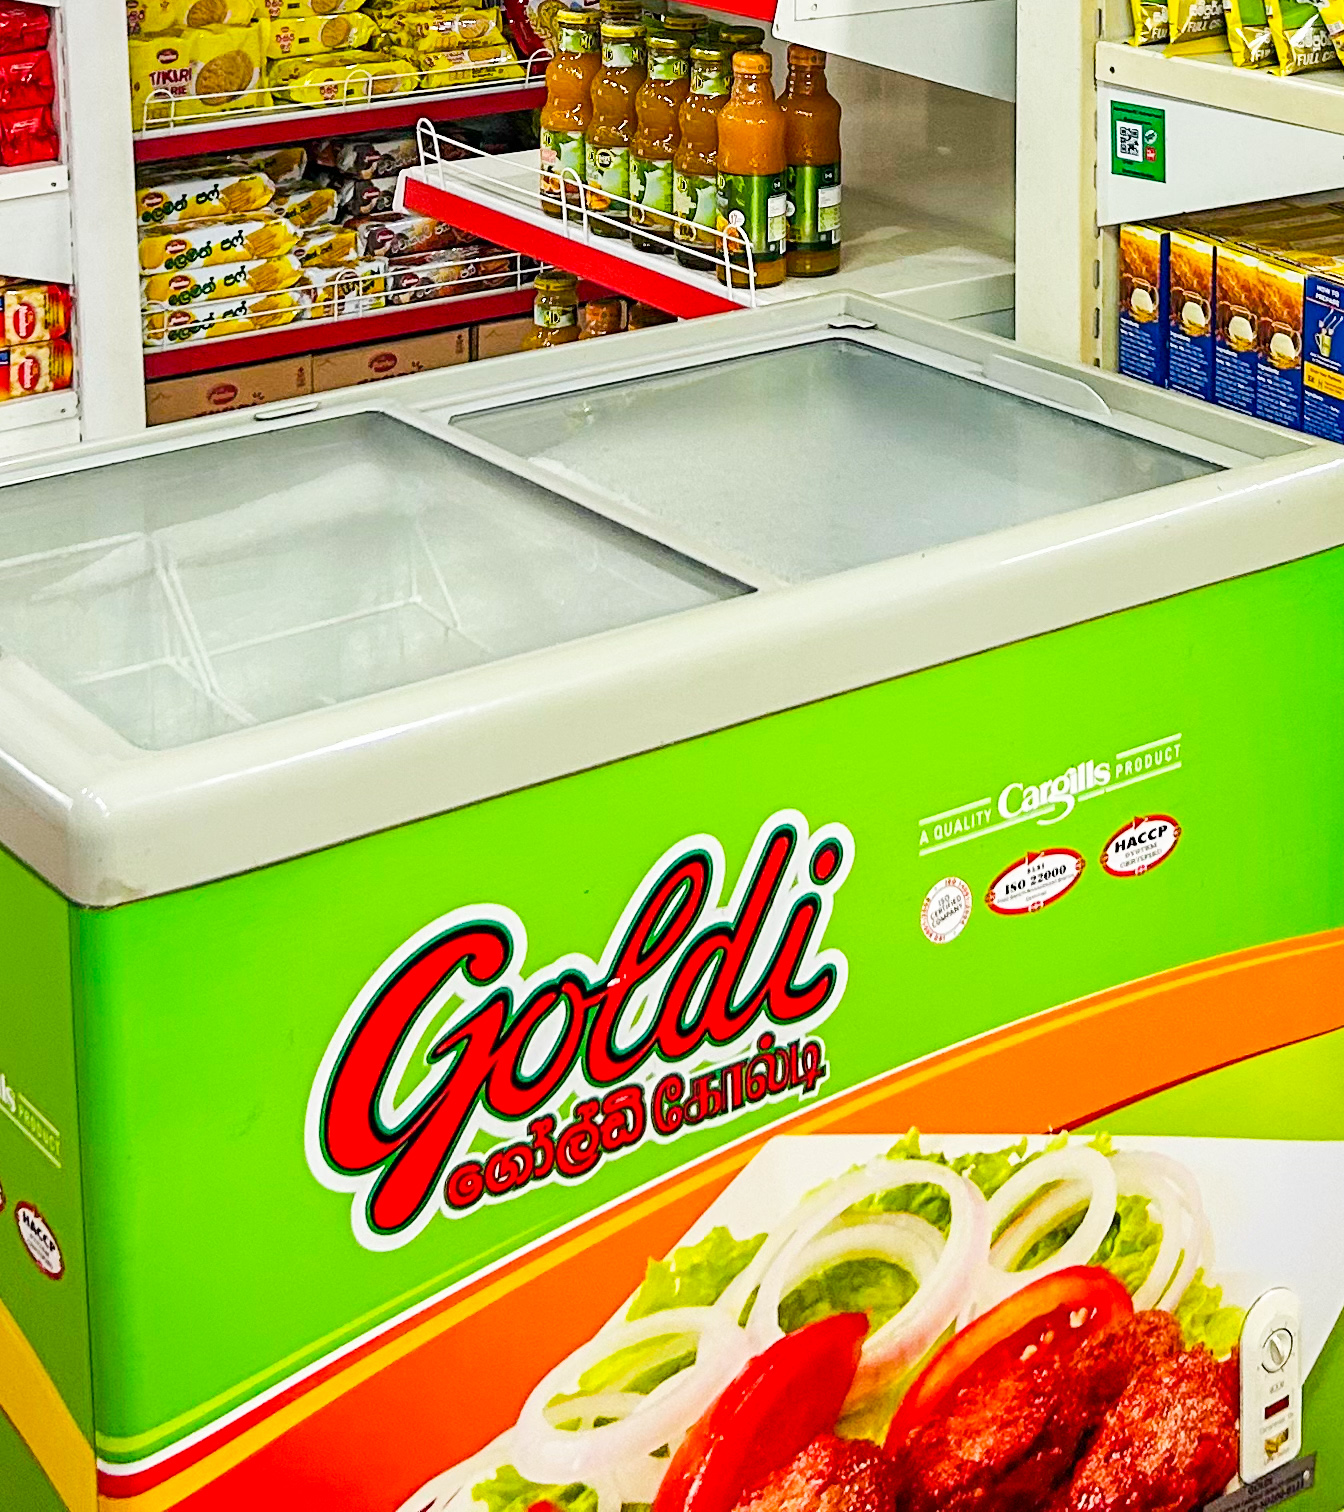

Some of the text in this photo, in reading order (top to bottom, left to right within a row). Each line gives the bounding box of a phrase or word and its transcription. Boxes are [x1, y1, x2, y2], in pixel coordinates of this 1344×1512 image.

[919, 744, 1182, 845] A QUALITY Cargills PRODUCT
[1115, 825, 1168, 853] HACCP
[1005, 879, 1026, 895] ISO
[1030, 865, 1067, 887] 22000
[320, 820, 838, 1236] Goldi
[18, 1211, 59, 1261] HACCP
